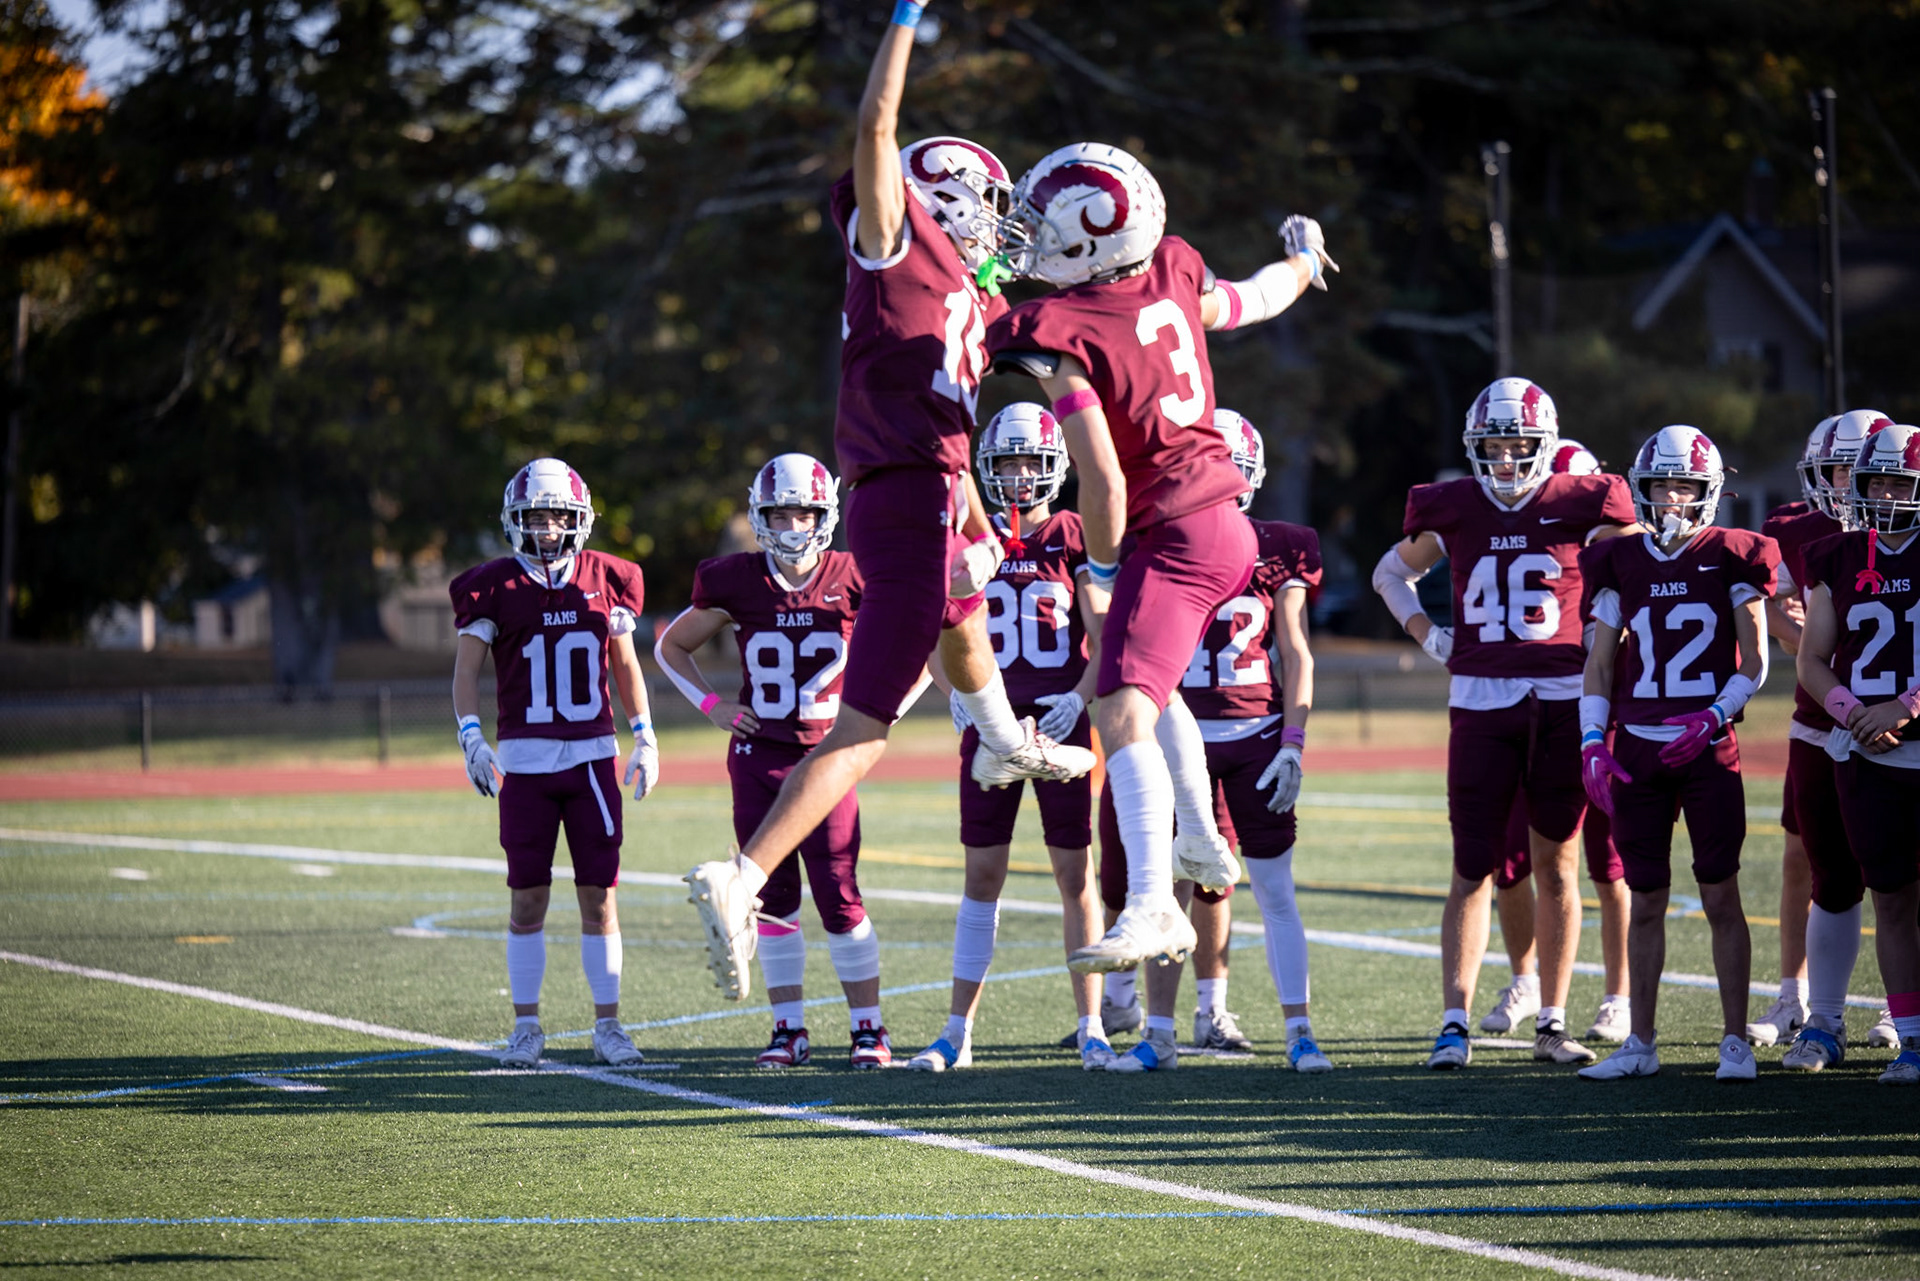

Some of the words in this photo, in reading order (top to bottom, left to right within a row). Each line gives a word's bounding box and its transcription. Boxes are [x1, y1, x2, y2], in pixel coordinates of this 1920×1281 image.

[1135, 298, 1206, 428] 3
[1000, 560, 1037, 574] RAMS
[1490, 535, 1527, 550] RAMS
[1463, 554, 1562, 642] 46
[1650, 582, 1688, 597] RAMS
[1871, 579, 1911, 595] AMS
[542, 610, 577, 626] RAMS
[776, 612, 813, 627] RAMS
[984, 580, 1070, 669] 80
[745, 631, 848, 720] 82
[1630, 602, 1718, 698] 12
[522, 631, 602, 724] 10
